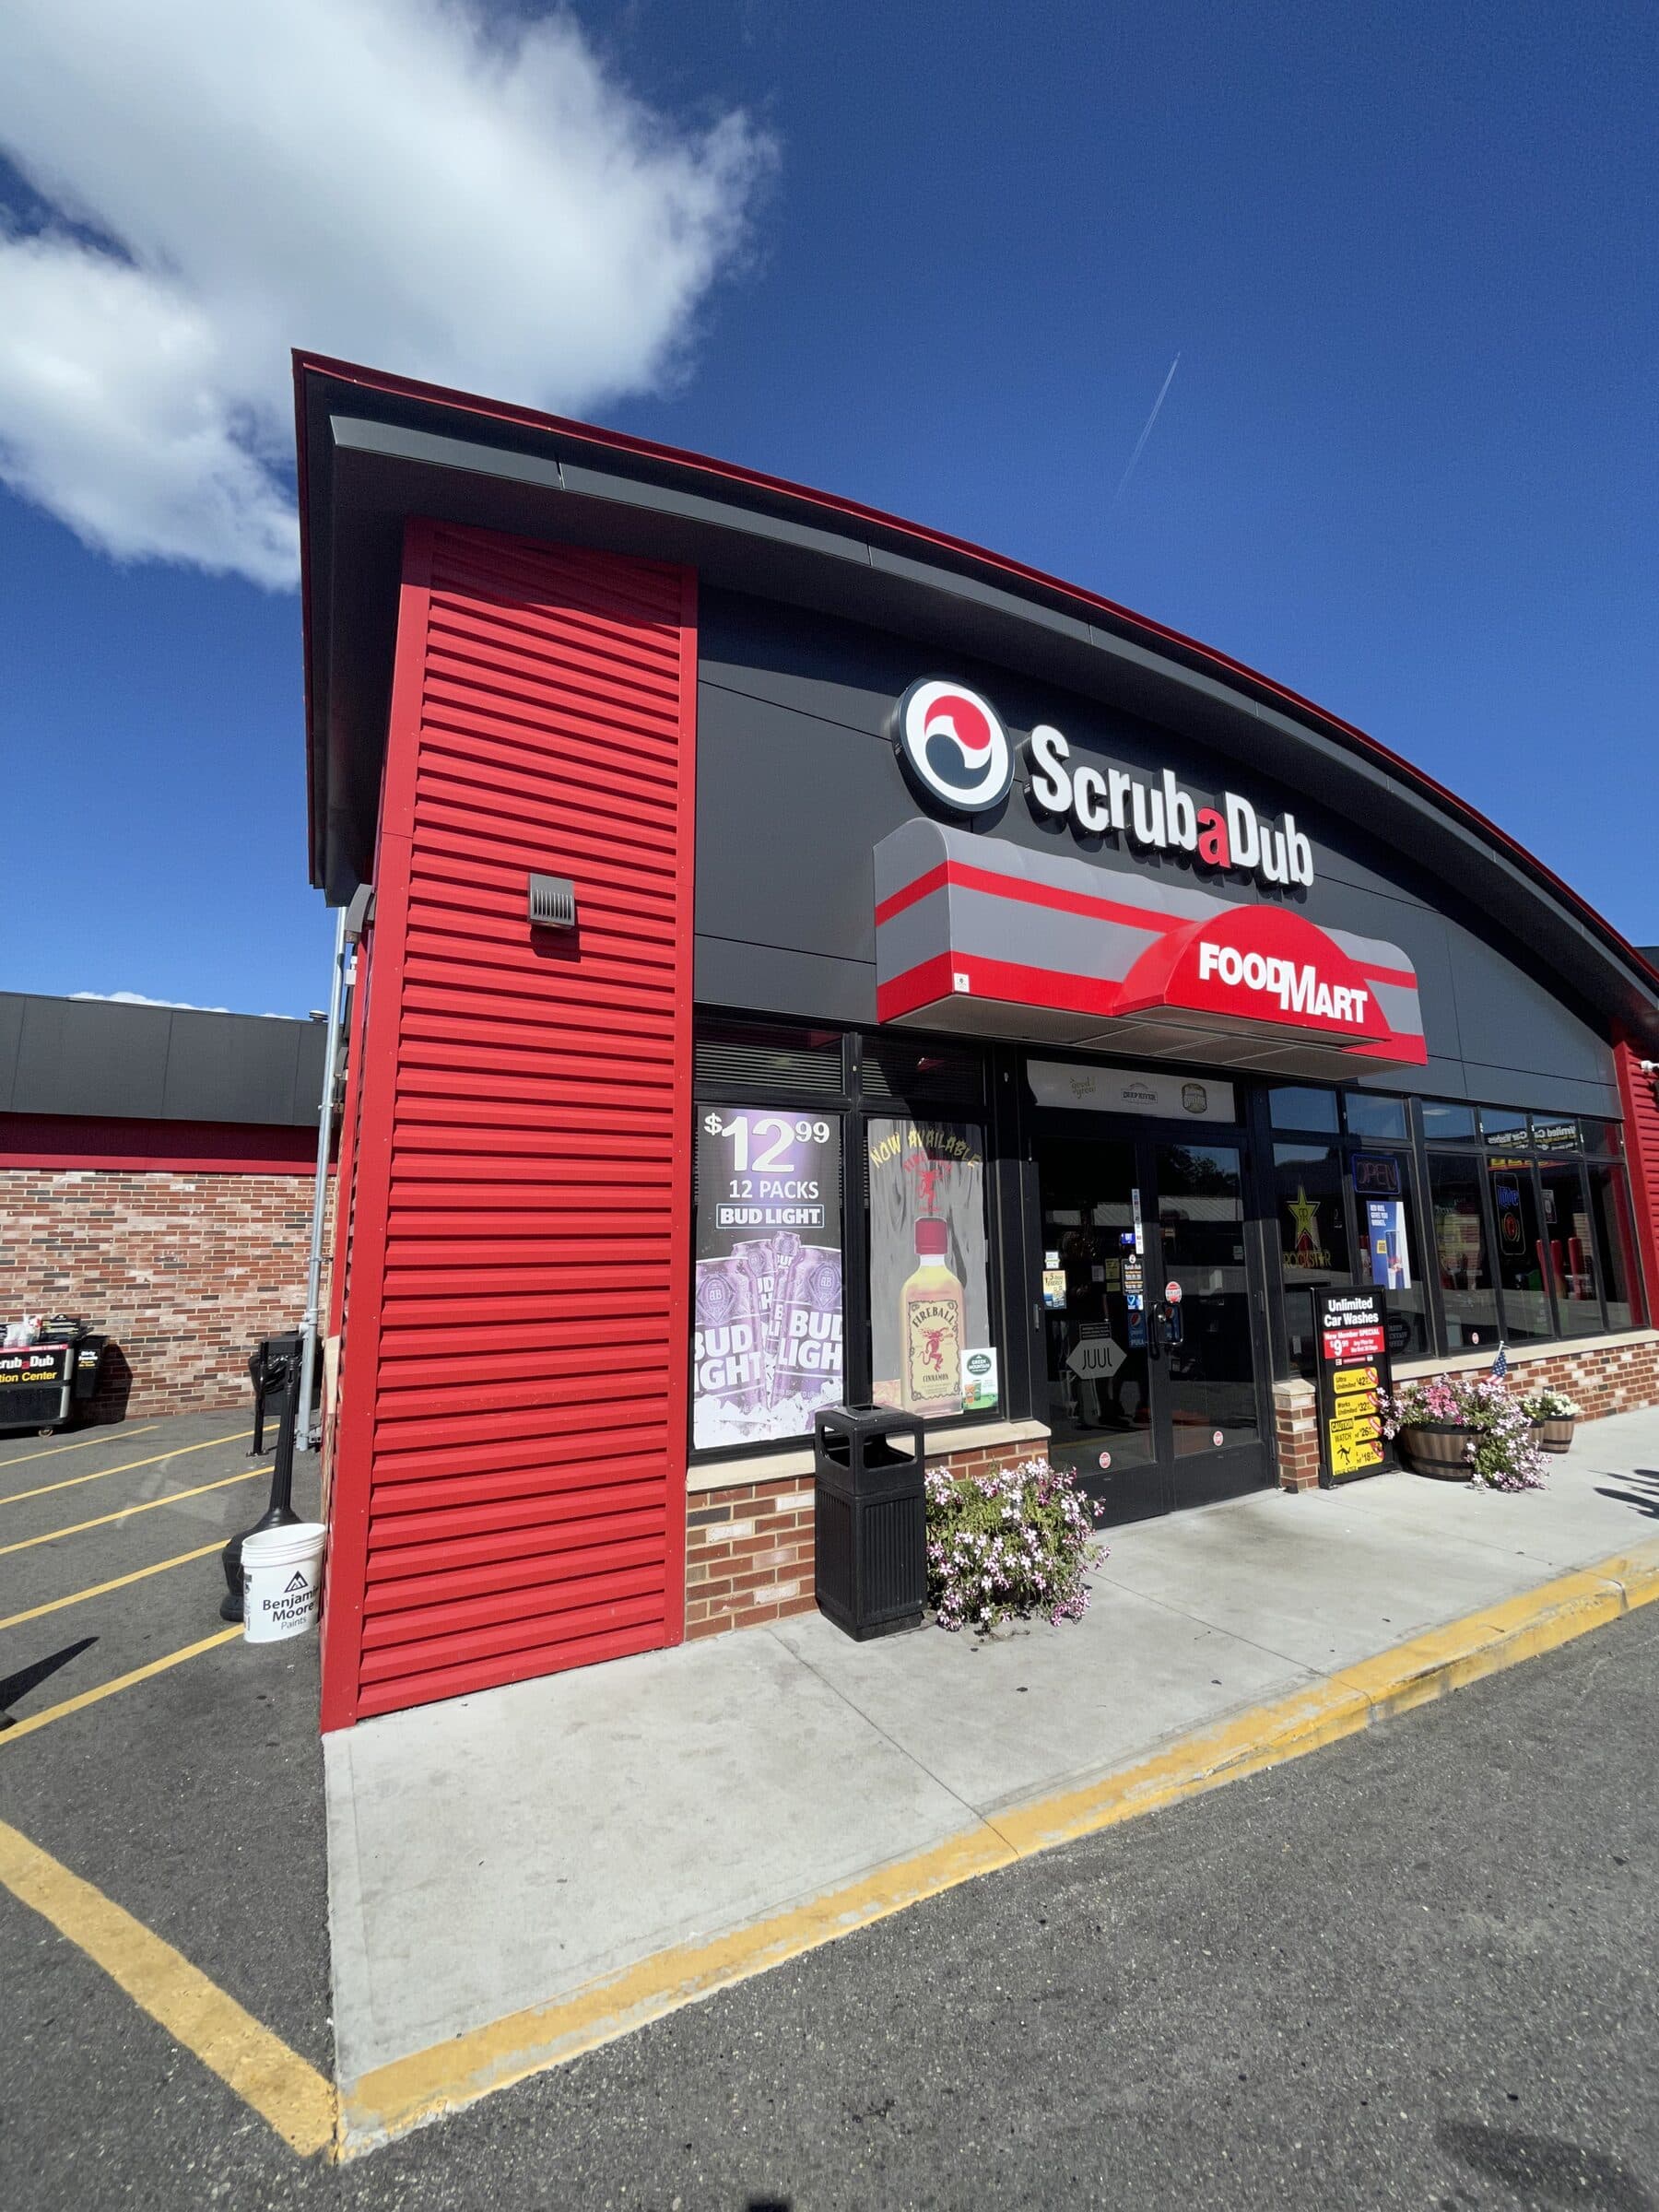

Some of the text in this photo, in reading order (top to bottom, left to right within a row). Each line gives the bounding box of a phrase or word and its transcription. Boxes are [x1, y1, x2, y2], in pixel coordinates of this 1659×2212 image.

[870, 1131, 901, 1169] NOW
[907, 1126, 982, 1171] AVAILABLE
[1357, 1160, 1397, 1191] OPEN
[729, 1180, 819, 1200] 12 PACKS
[720, 1207, 820, 1225] BUD LIGHT
[1328, 1297, 1373, 1312] Unlimited
[912, 1306, 956, 1328] FIREBALL
[1324, 1312, 1379, 1327] Car Washes
[0, 1354, 55, 1370] rubaDub
[779, 1337, 842, 1371] LIGH
[1082, 1347, 1113, 1371] JUUL
[0, 1371, 57, 1383] tion Center
[1332, 1421, 1353, 1432] CAUTION
[1335, 1431, 1352, 1442] WATCH
[272, 1602, 314, 1622] Moore
[281, 1616, 306, 1630] Paints
